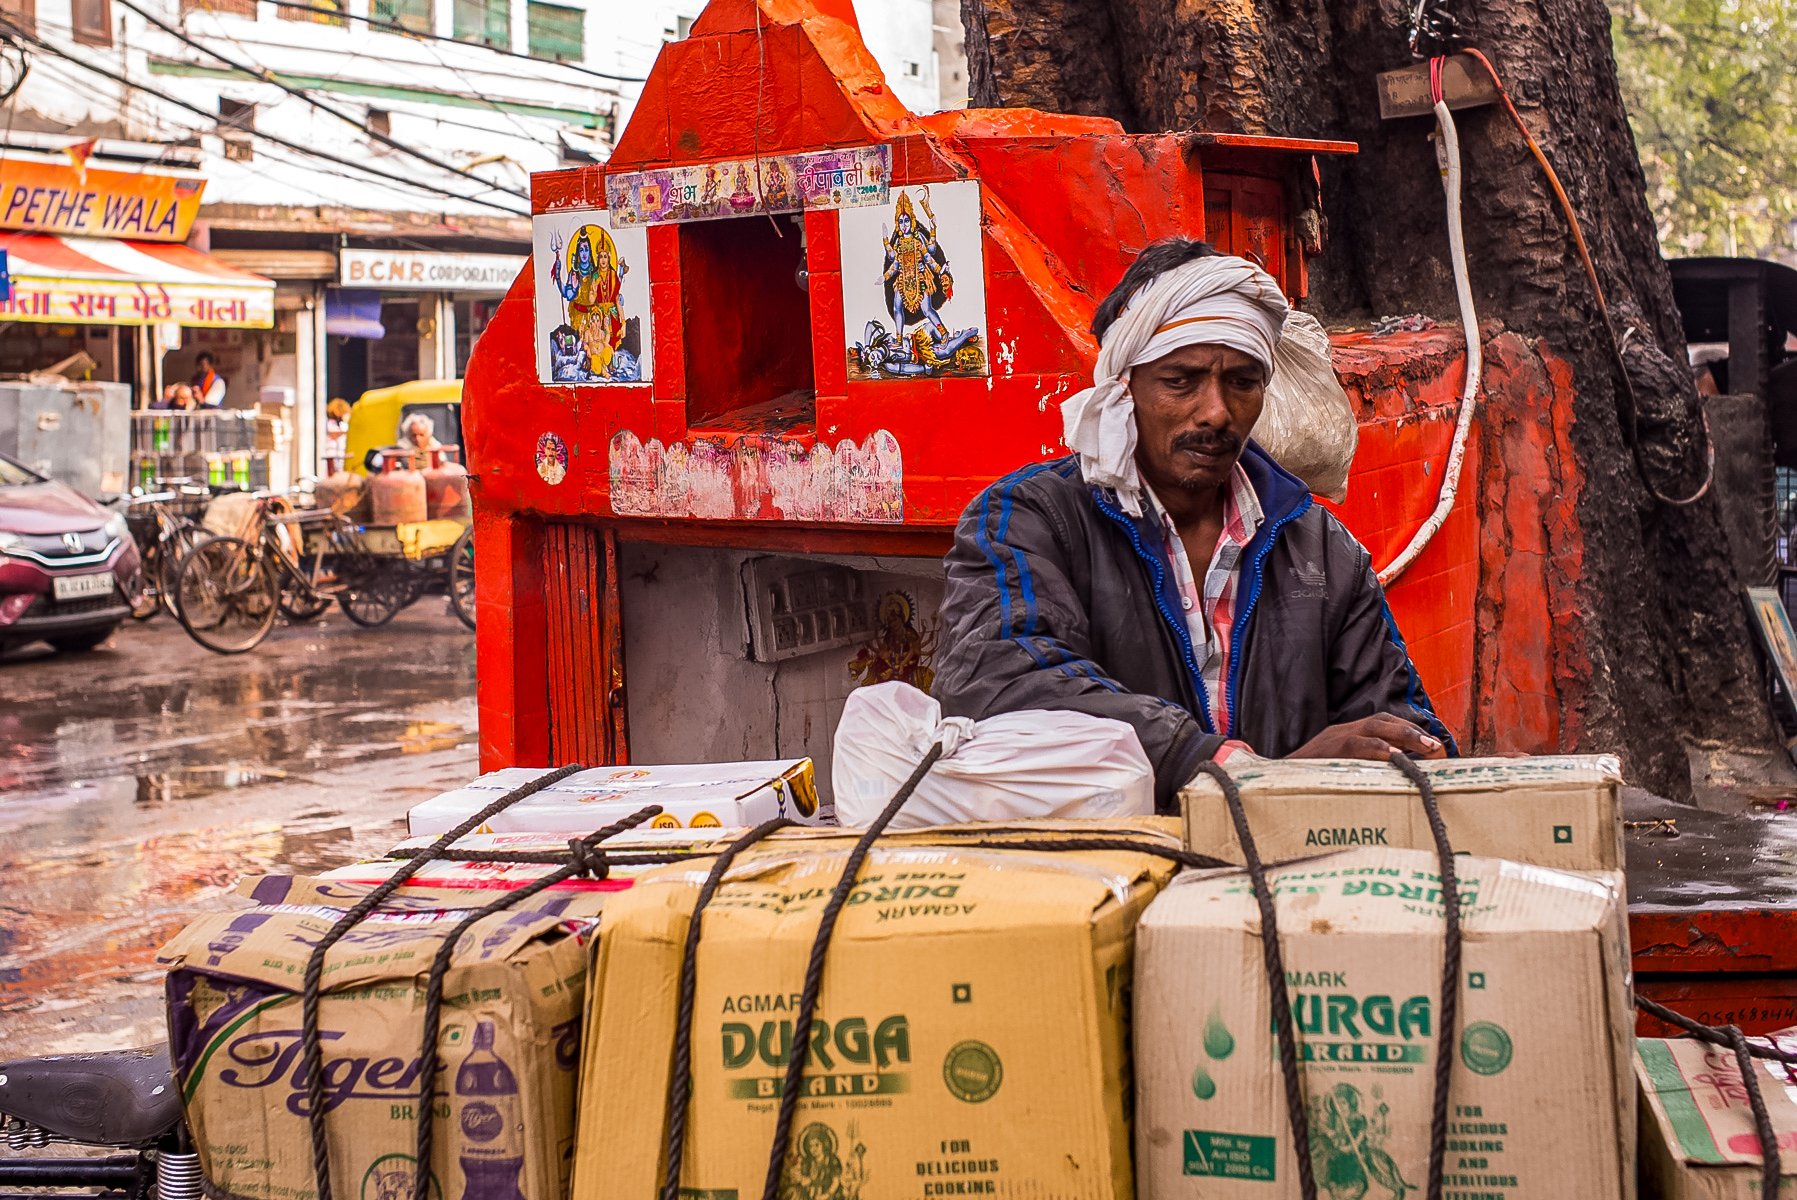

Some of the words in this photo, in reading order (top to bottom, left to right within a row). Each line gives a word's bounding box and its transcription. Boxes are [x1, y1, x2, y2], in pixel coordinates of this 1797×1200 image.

[5, 187, 97, 227] PETHE
[103, 195, 178, 235] WALA
[69, 293, 117, 318] राम
[189, 298, 248, 321] वाला
[1305, 827, 1388, 846] AGMARK
[877, 903, 977, 922] AGMARK
[1285, 971, 1347, 987] MARK
[1271, 993, 1432, 1041] URGA
[721, 1014, 912, 1071] DURGA
[1312, 1043, 1404, 1062] RAND
[756, 1075, 881, 1098] BAND
[1456, 1106, 1483, 1117] FOR
[941, 1140, 971, 1154] FOR
[916, 1160, 999, 1176] DELICIOUS
[1458, 1157, 1489, 1169] AND
[924, 1180, 996, 1197] COOKING
[1441, 1174, 1518, 1187] UTRITIOUS
